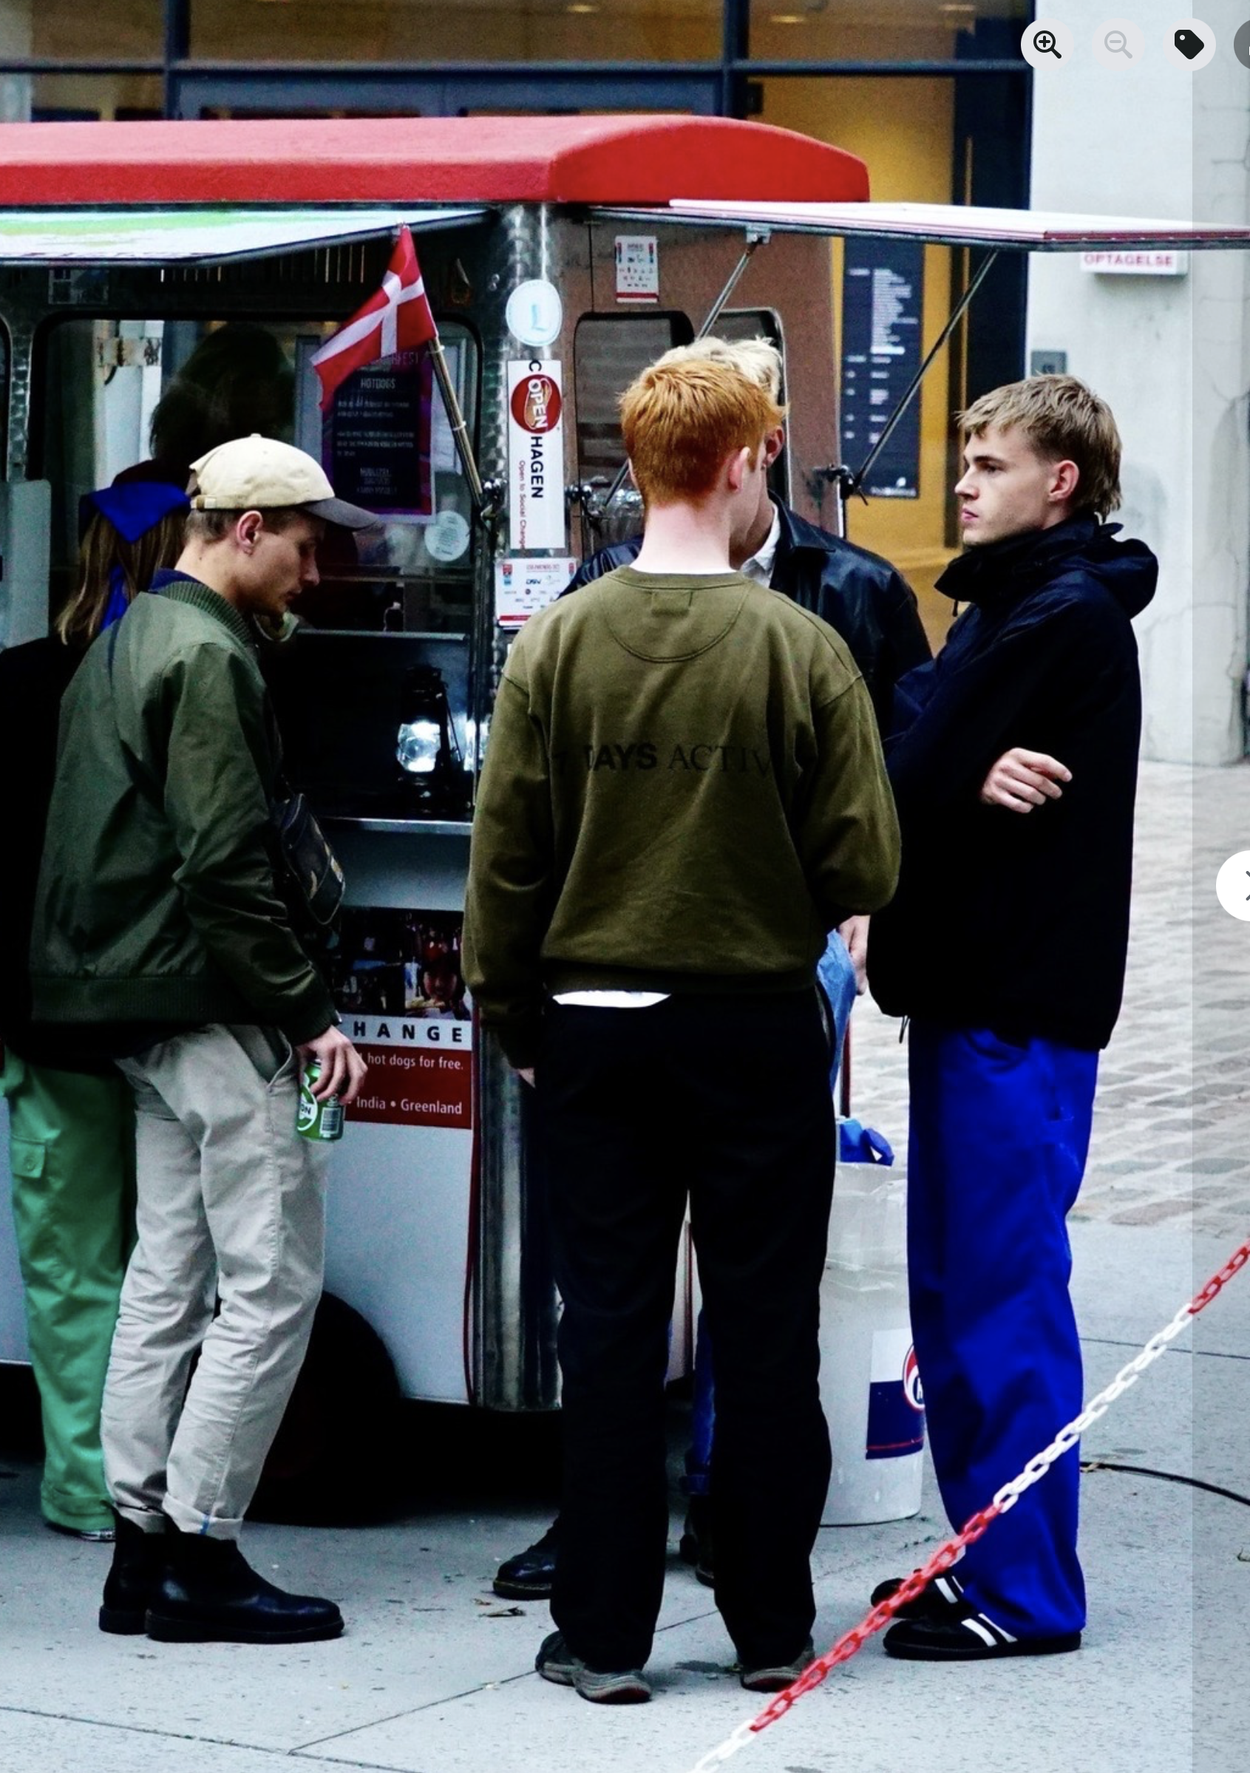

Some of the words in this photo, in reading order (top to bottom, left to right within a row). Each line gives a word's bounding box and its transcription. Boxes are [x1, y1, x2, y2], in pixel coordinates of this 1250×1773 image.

[1084, 253, 1173, 267] OPTAGELSE
[360, 377, 396, 390] HOTDOGS
[668, 744, 771, 778] ACTIV
[353, 1021, 463, 1043] HANGE
[367, 1052, 387, 1066] hot
[389, 1054, 416, 1070] dogs
[419, 1055, 435, 1068] for
[438, 1056, 464, 1070] free.
[356, 1096, 386, 1110] India
[400, 1099, 463, 1115] Greenland
